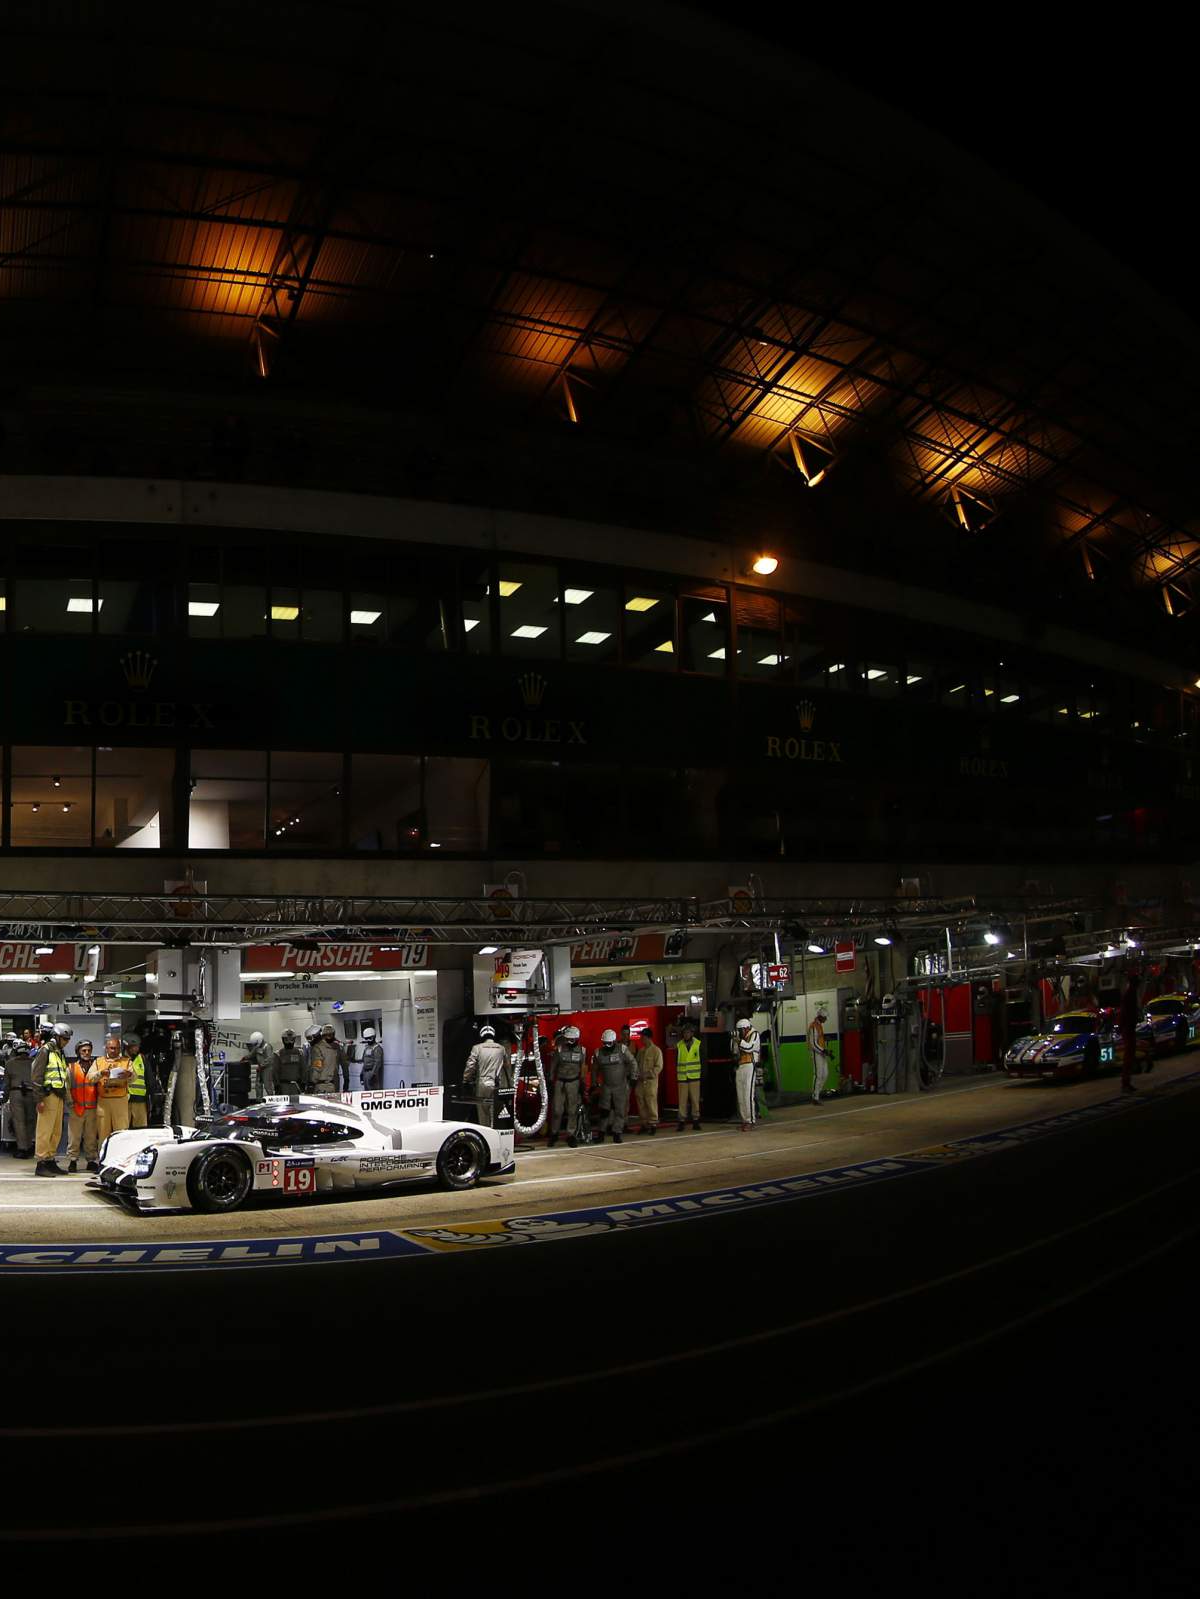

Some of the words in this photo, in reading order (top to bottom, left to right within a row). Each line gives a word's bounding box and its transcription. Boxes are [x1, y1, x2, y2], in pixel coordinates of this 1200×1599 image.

[63, 699, 216, 728] ROLEX
[468, 713, 588, 744] ROLEX
[764, 735, 846, 764] ROLEX
[281, 944, 373, 968] PORSCHE
[404, 945, 425, 966] 19
[778, 967, 788, 978] 62
[274, 982, 300, 990] Porsche
[1099, 1047, 1114, 1062] 51
[361, 1088, 440, 1100] PORSCHE
[361, 1101, 392, 1111] DMG
[395, 1098, 428, 1109] MORI
[360, 1154, 407, 1163] PORSCHE
[258, 1164, 270, 1173] P1
[287, 1169, 311, 1191] 19
[606, 1162, 905, 1222] MICHELIN
